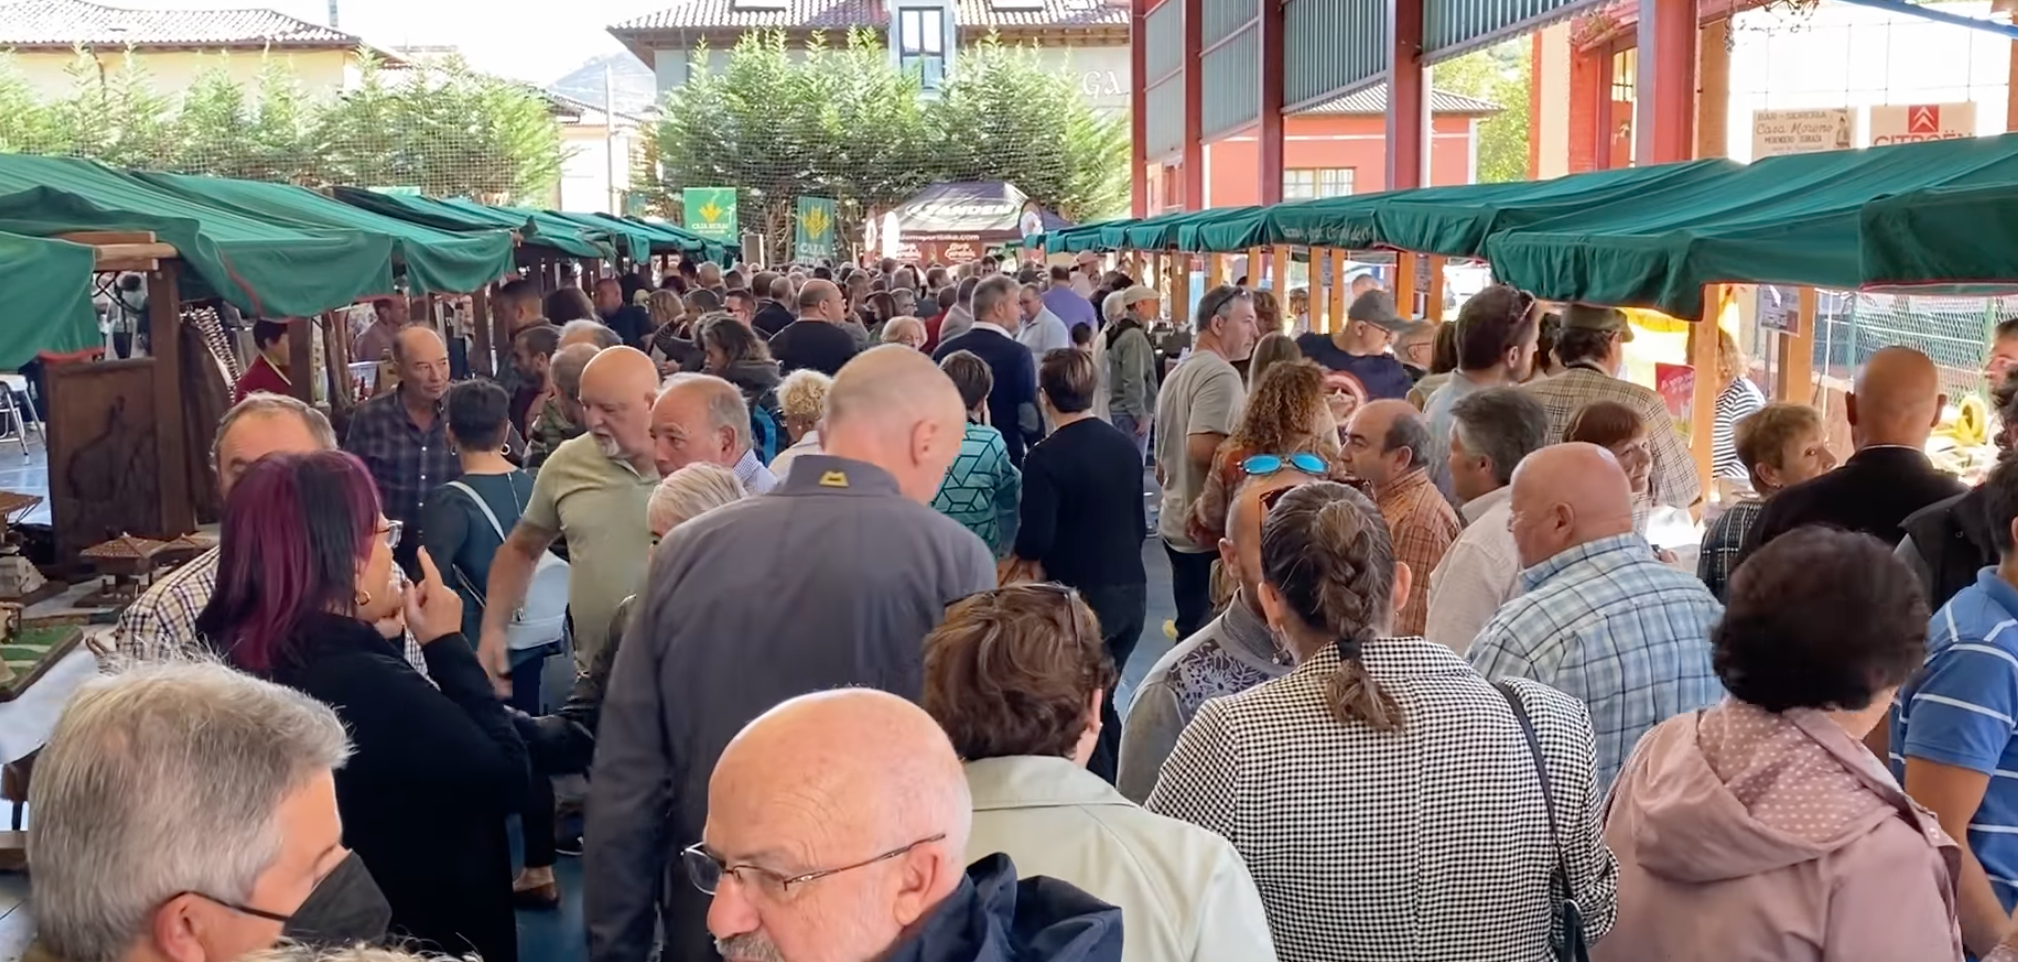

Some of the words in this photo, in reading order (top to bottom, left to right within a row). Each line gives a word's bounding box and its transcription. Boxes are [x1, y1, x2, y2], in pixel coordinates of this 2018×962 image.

[1757, 112, 1777, 121] BAR
[1756, 123, 1786, 135] Casa
[1790, 122, 1834, 134] Moreno
[799, 242, 826, 255] CAJA
